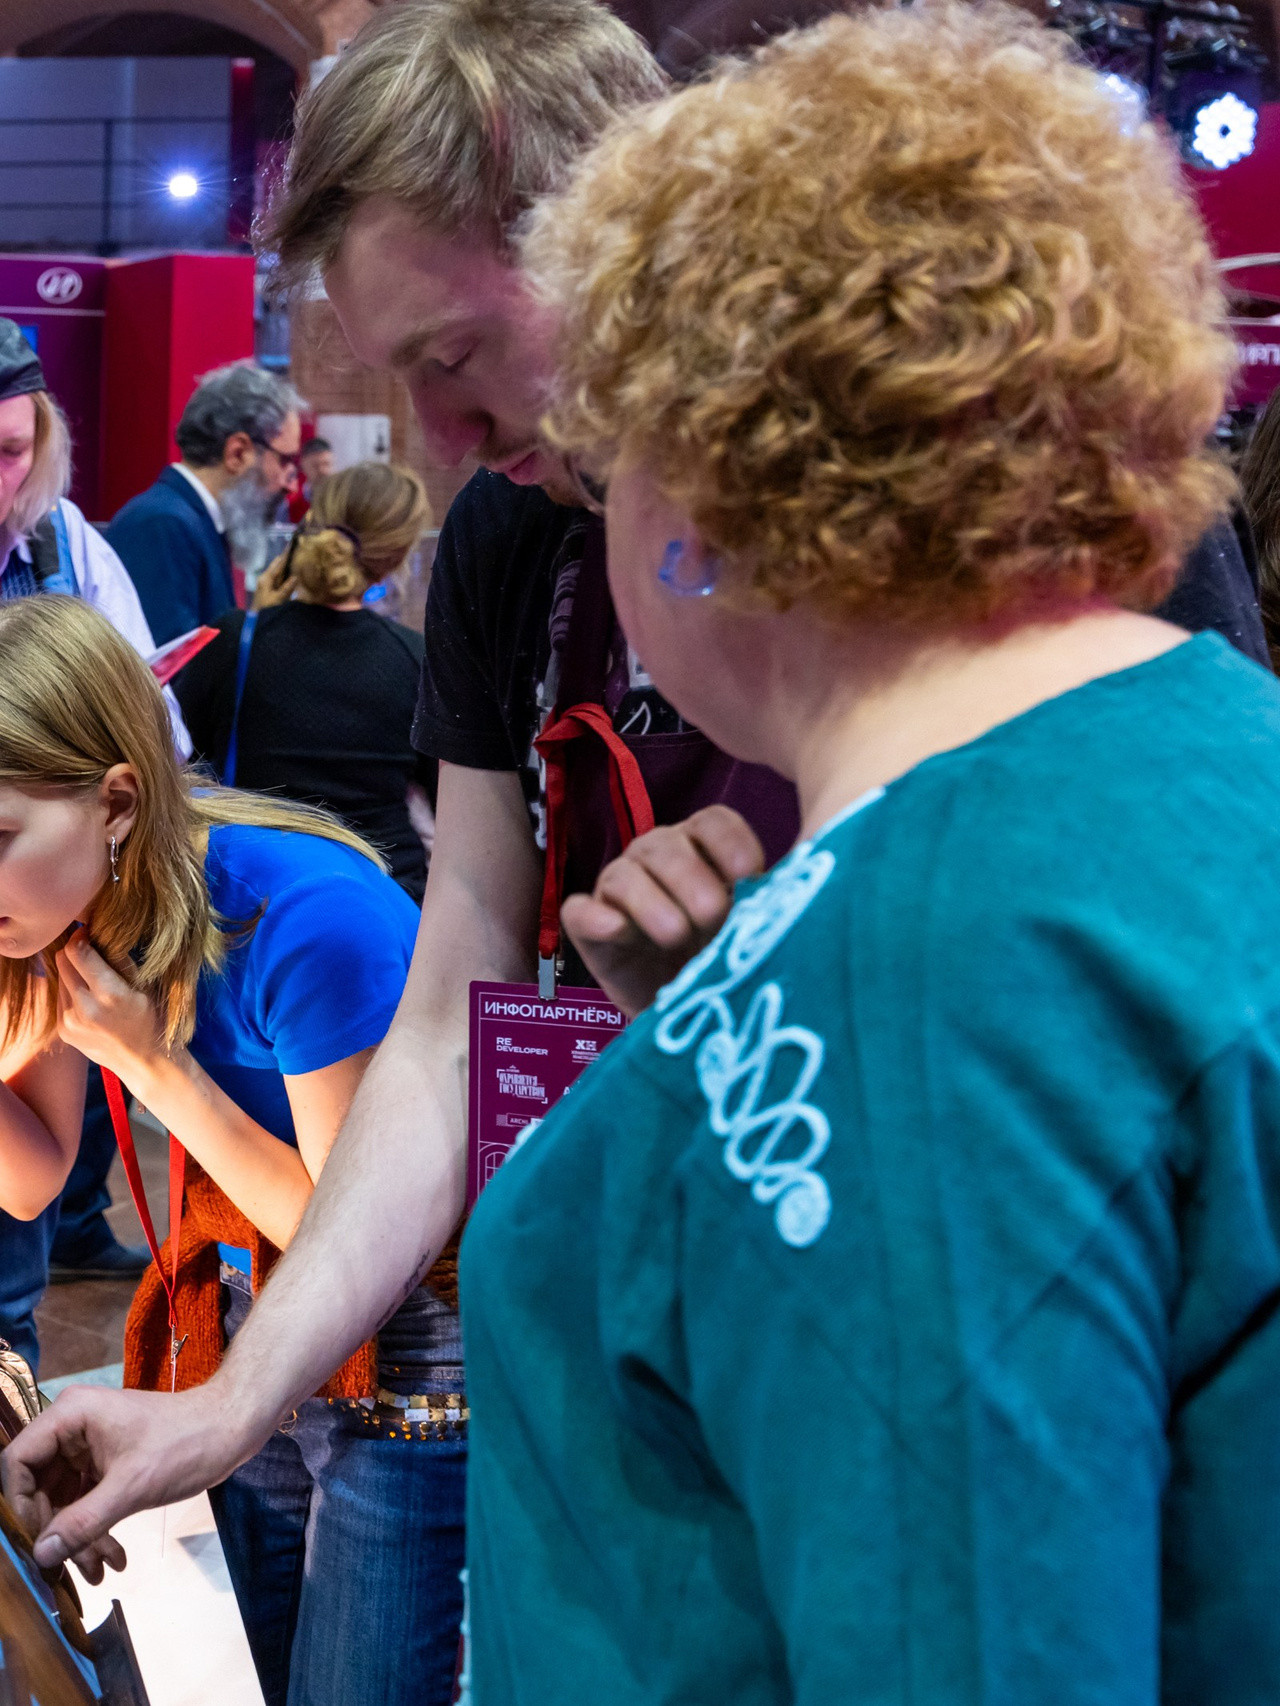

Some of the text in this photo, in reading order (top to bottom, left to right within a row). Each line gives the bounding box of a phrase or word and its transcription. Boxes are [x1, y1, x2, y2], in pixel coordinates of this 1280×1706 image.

[485, 1001, 621, 1025] ИНФОПАРТНЁРЫ
[496, 1037, 512, 1046] RE
[496, 1045, 548, 1056] DEVELOPER
